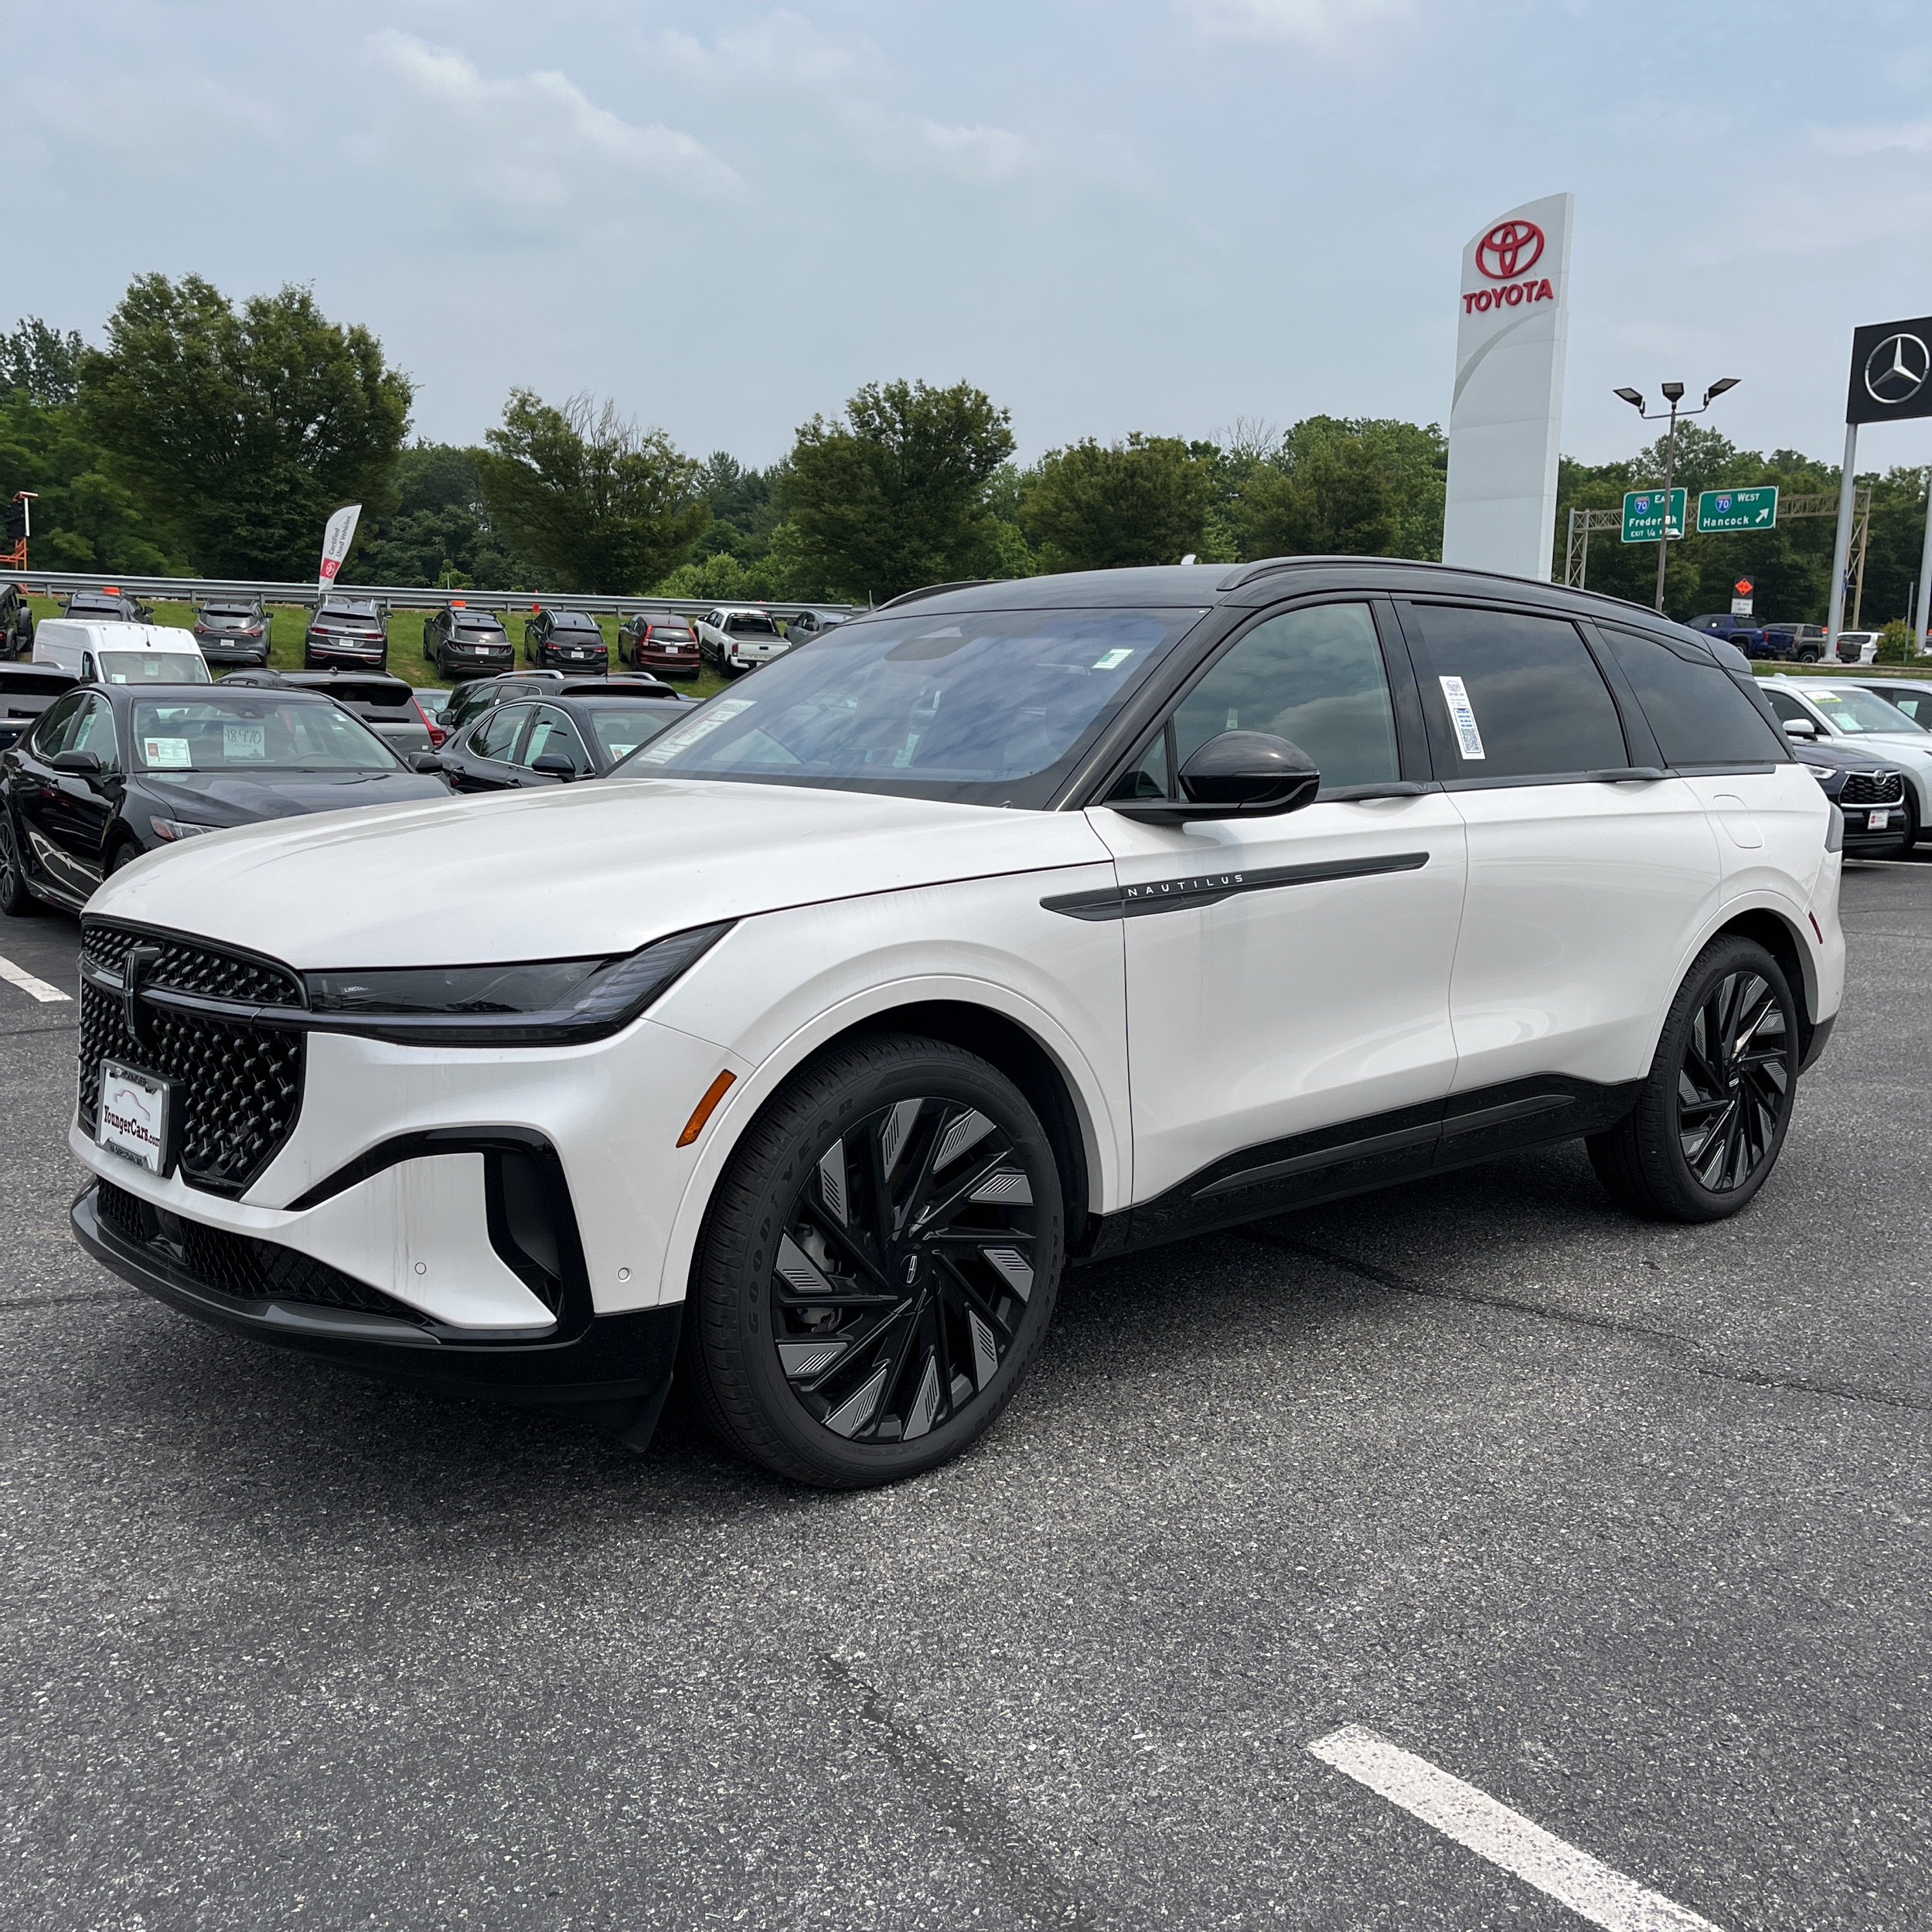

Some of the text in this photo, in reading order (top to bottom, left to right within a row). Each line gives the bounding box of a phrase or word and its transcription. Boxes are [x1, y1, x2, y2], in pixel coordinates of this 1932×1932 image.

[1463, 278, 1553, 314] TOYOTA
[1637, 495, 1675, 510] 70 EAT
[1718, 493, 1760, 509] 70 WEST
[1629, 515, 1677, 527] Frederk
[1703, 515, 1749, 527] Hancock
[329, 527, 340, 555] Certified
[336, 516, 351, 557] Used Vehicles
[1127, 874, 1243, 897] NAUTILUS
[104, 1105, 160, 1147] YoungerCars.com
[748, 1097, 854, 1334] GOODYEAR
